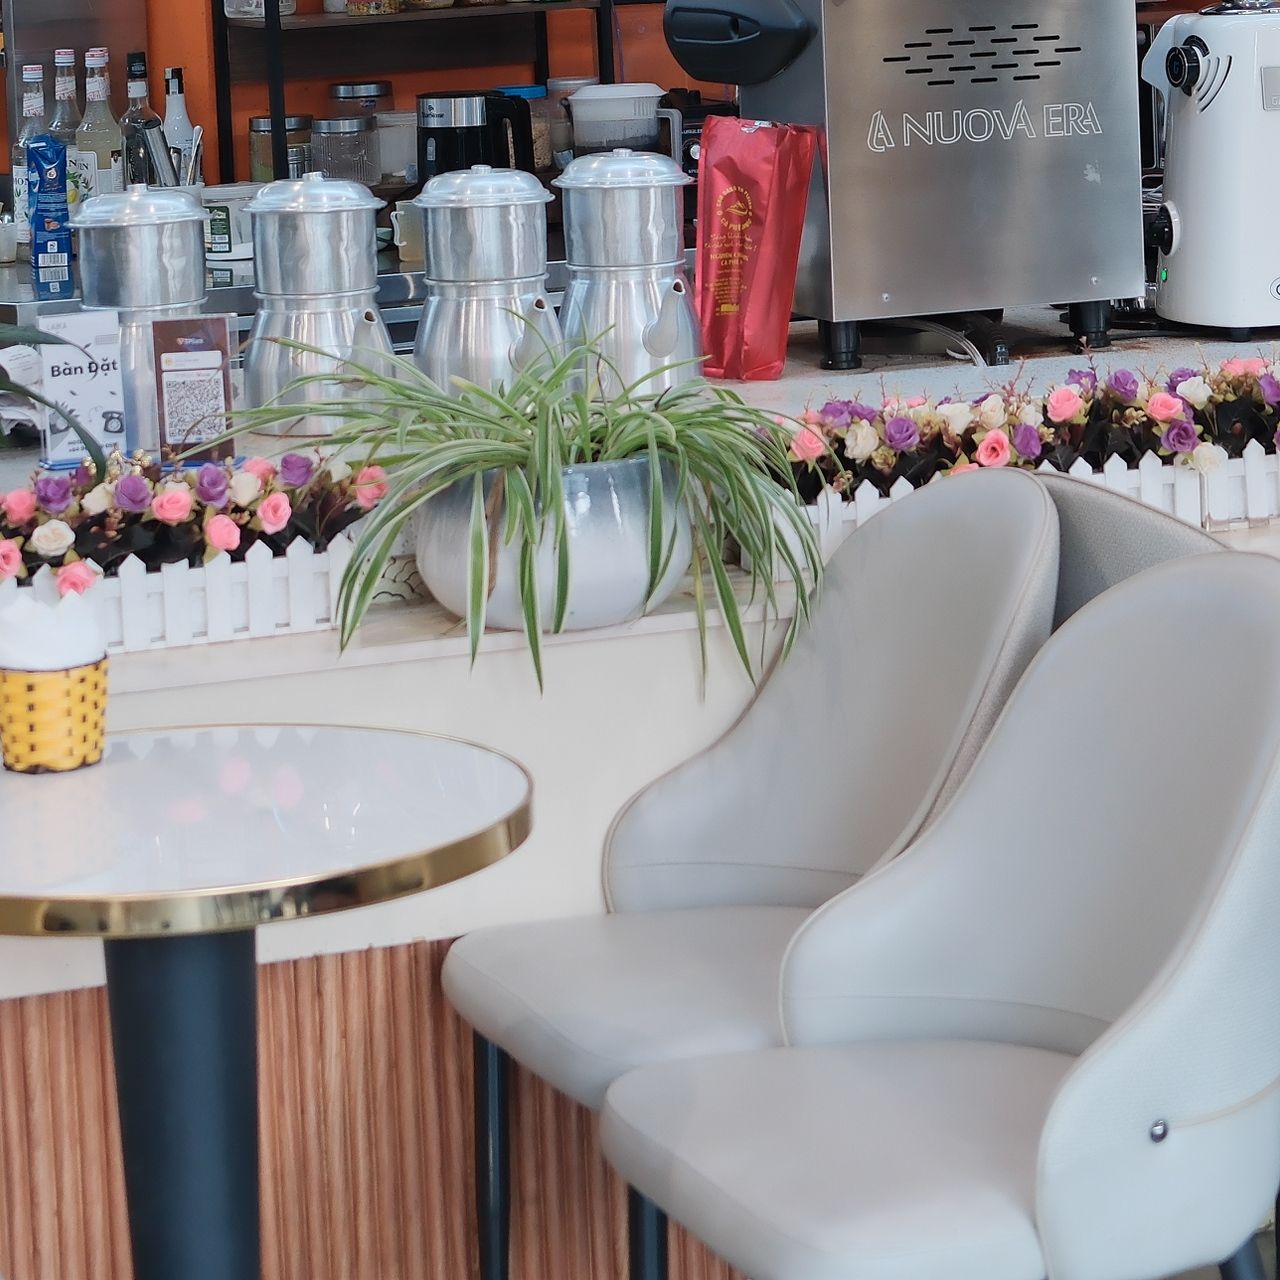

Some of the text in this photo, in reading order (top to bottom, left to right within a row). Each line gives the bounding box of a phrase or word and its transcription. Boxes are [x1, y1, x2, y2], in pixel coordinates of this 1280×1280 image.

[903, 99, 1037, 146] NUOVA
[1043, 101, 1102, 137] ERA
[51, 361, 83, 377] Bàn
